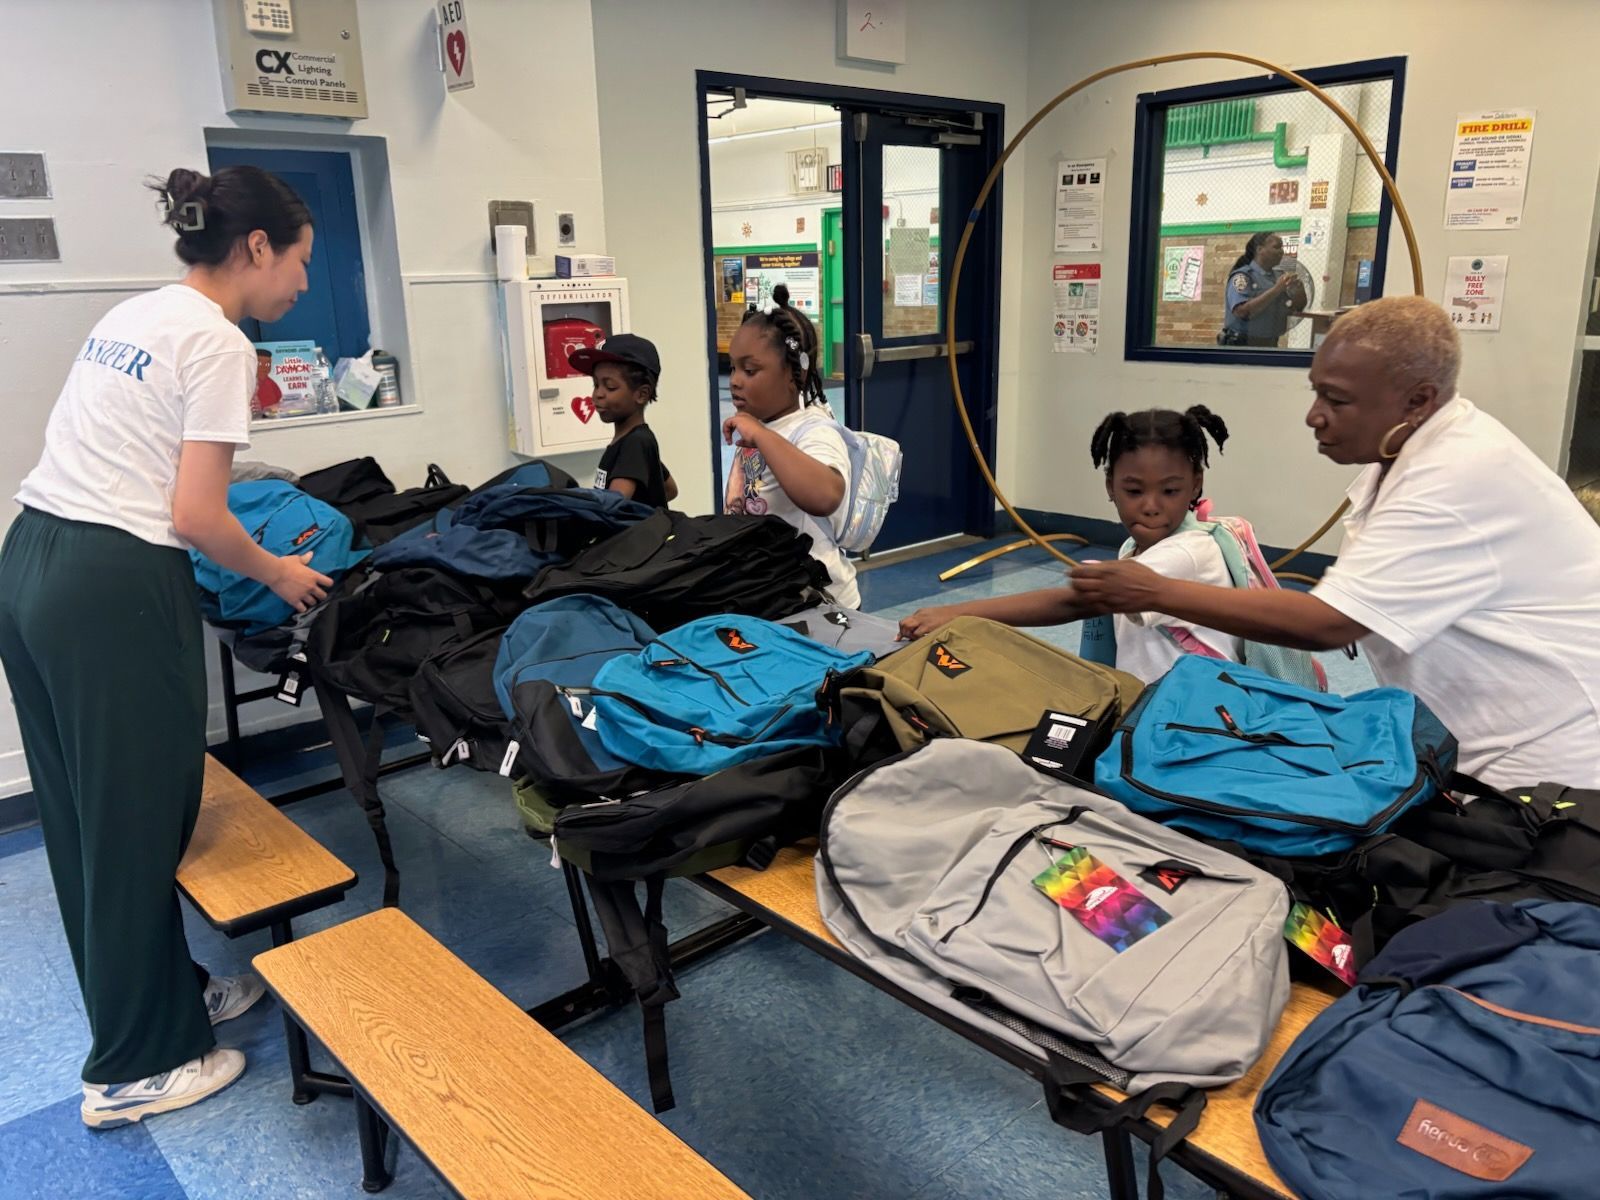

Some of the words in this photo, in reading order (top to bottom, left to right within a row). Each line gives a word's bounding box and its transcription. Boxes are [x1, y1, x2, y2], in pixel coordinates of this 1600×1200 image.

[442, 0, 462, 26] AED
[256, 49, 295, 75] CX
[291, 52, 336, 64] Commercial
[298, 64, 332, 76] Lighting
[285, 76, 317, 86] Control
[320, 79, 346, 88] Panels
[1462, 124, 1490, 133] FIRE
[1491, 122, 1528, 131] DRILL
[540, 292, 612, 300] DEFIBRILLATOR
[288, 382, 307, 390] EARN
